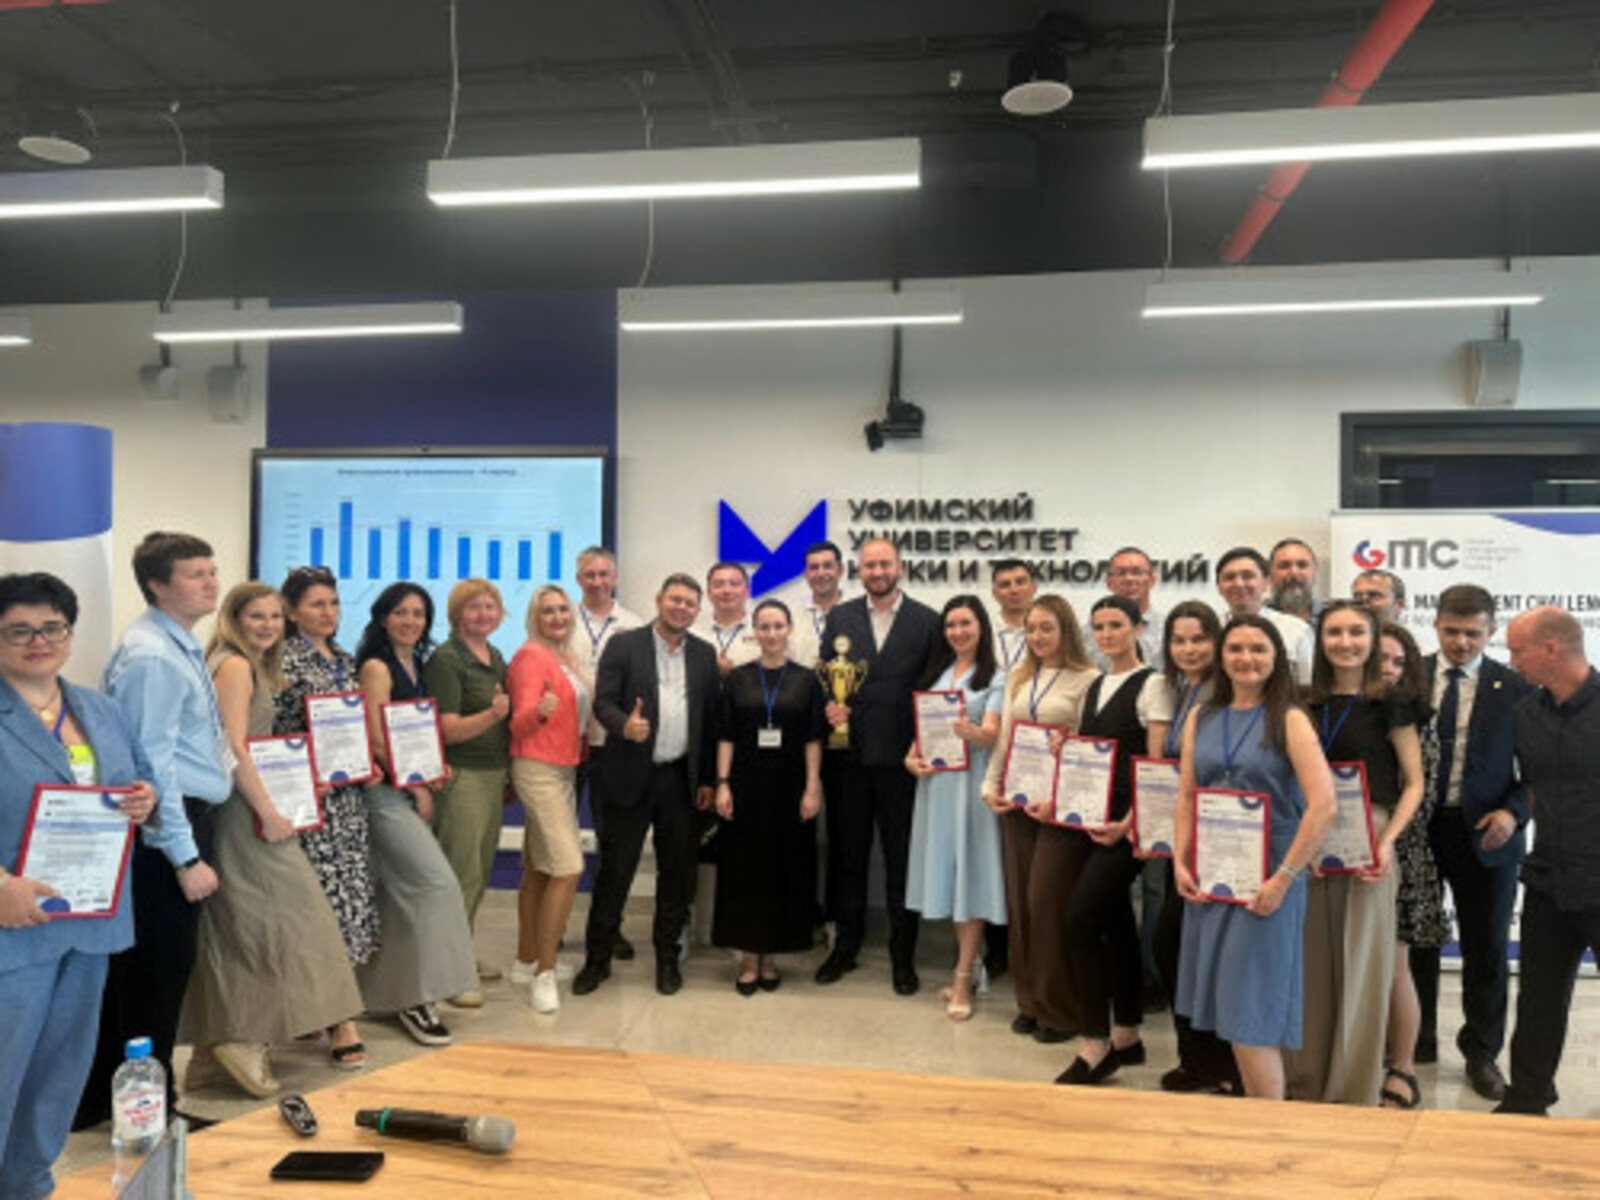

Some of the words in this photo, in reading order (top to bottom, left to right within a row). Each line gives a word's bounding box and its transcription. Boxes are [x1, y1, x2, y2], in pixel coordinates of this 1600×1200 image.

[848, 493, 1034, 522] УФИМСКИЙ
[848, 559, 949, 583] НКИ
[958, 559, 980, 582] И
